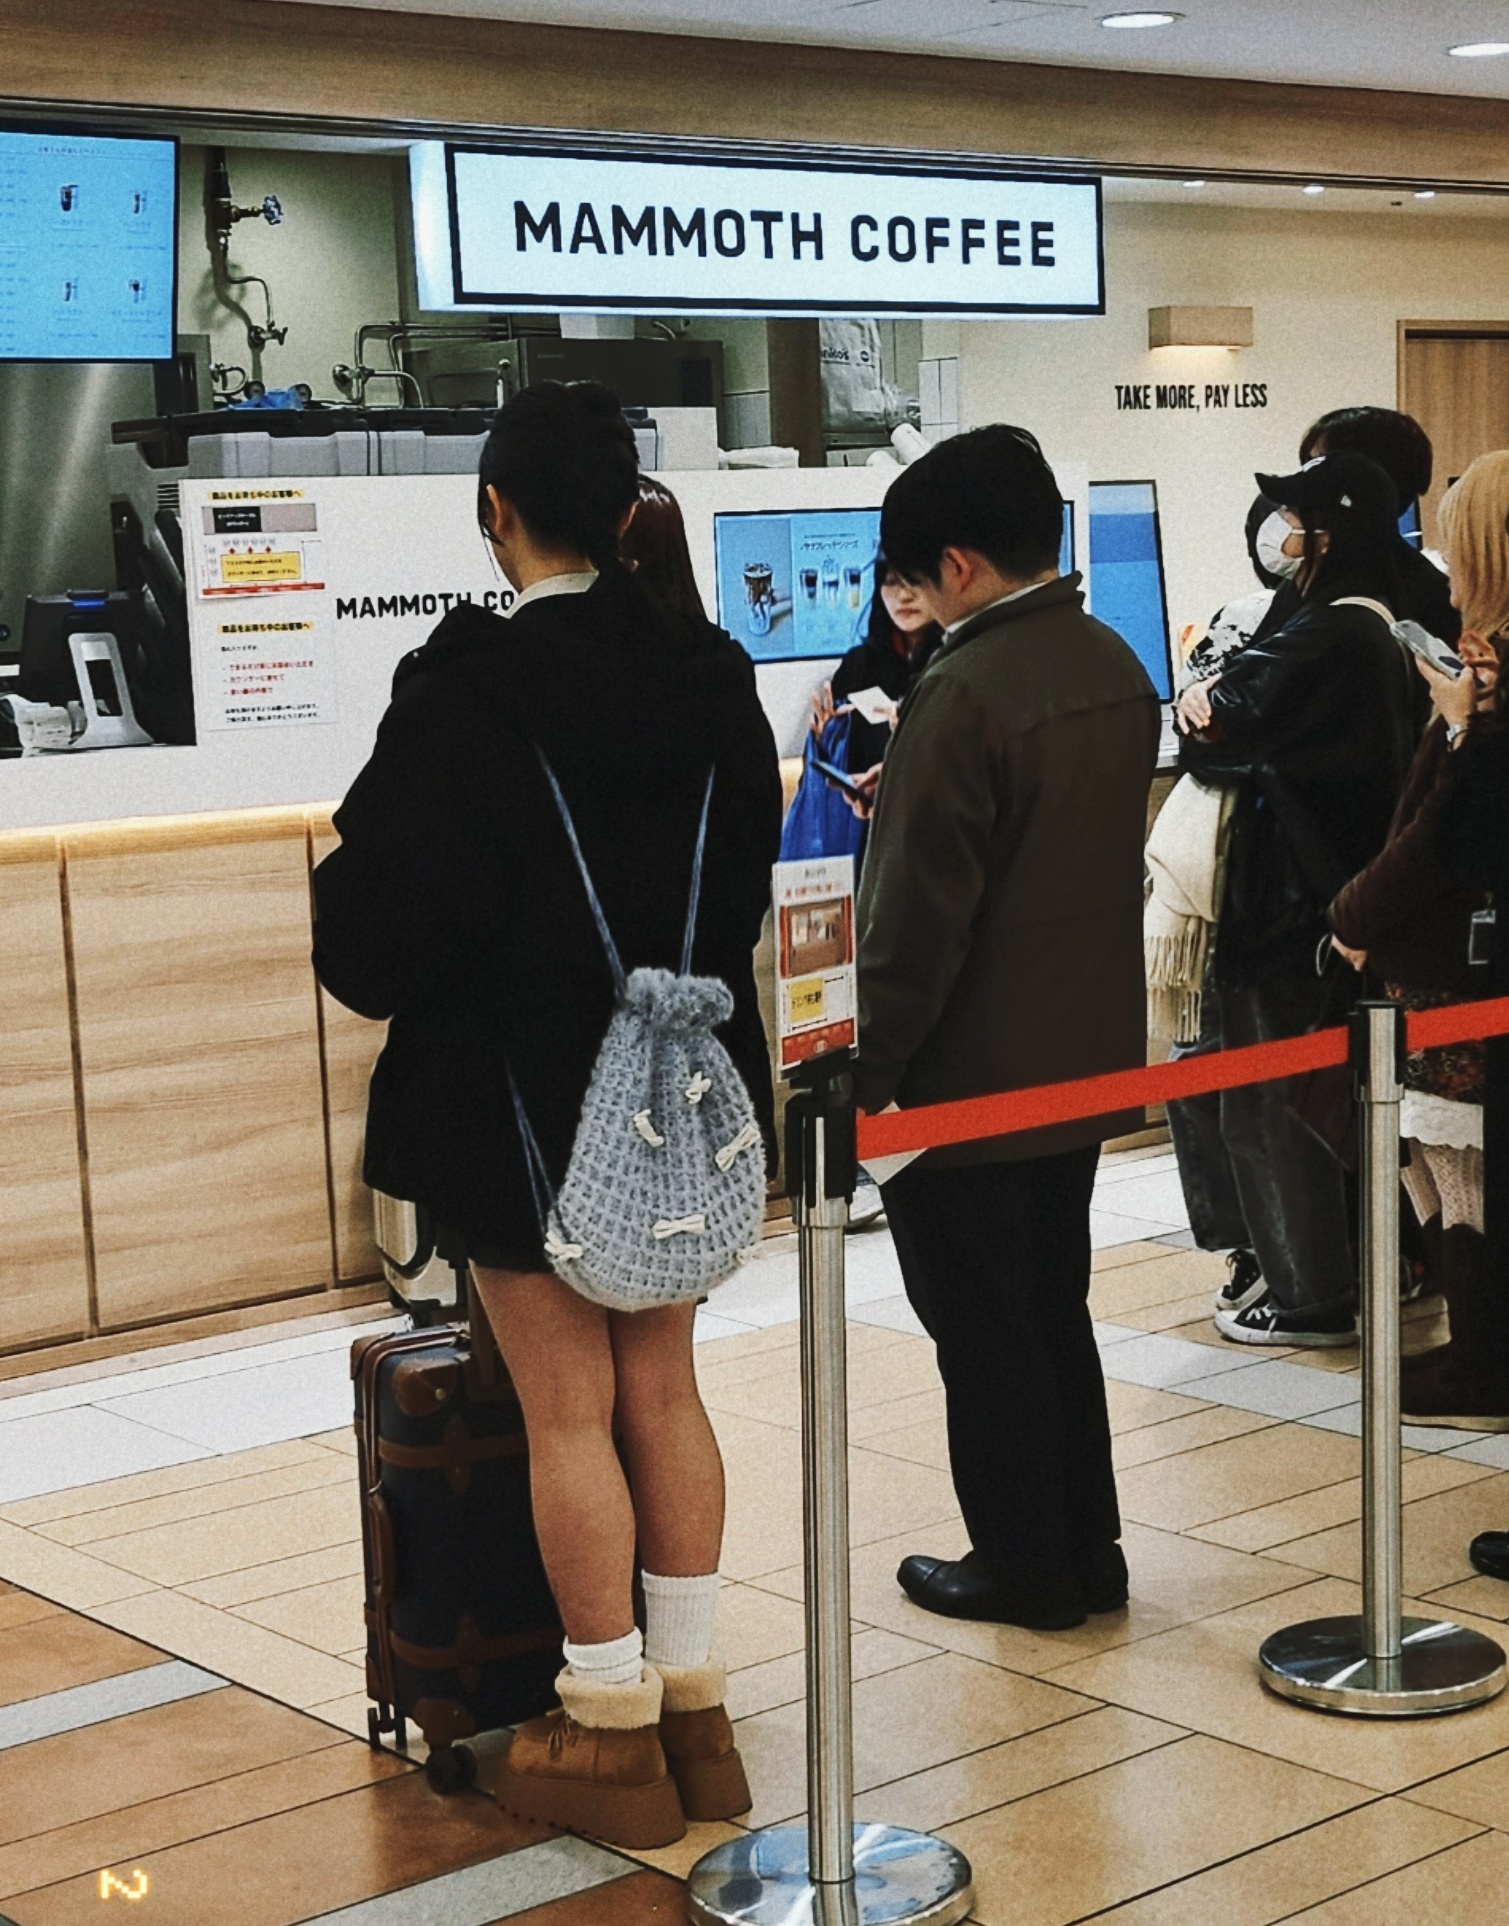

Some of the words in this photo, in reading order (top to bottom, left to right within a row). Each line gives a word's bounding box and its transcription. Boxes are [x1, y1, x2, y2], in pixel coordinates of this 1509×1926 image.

[514, 201, 823, 260] MAMMOTH
[851, 215, 1055, 266] COFFEE
[1115, 385, 1151, 409] TAKE
[1156, 385, 1199, 411] MORE,
[1206, 385, 1229, 408] PAY
[1235, 384, 1267, 408] LESS
